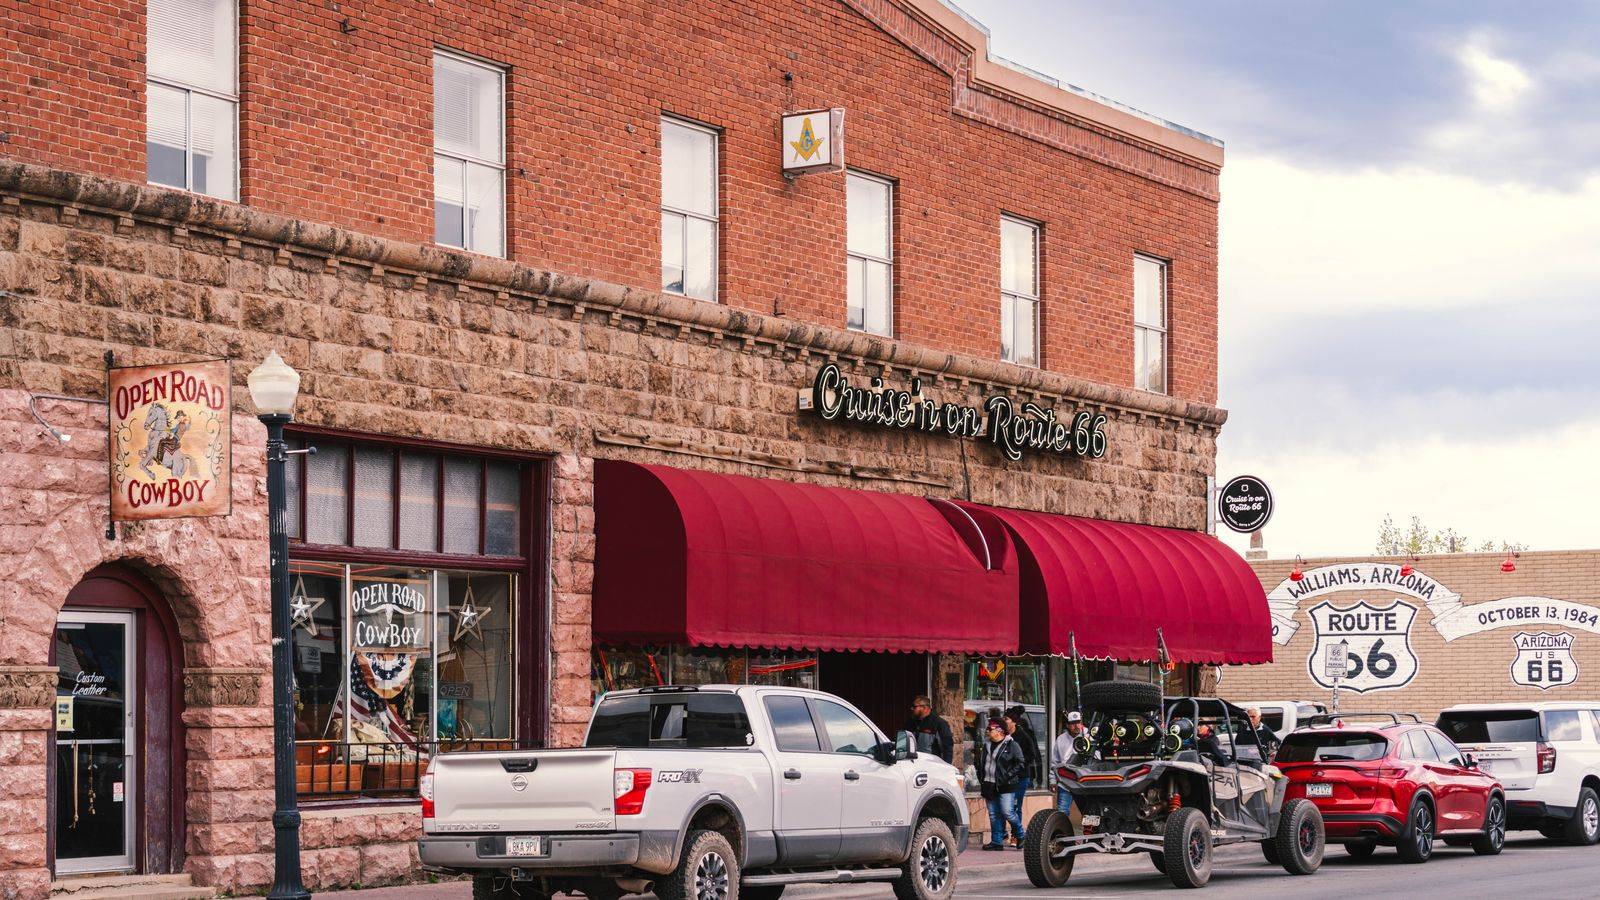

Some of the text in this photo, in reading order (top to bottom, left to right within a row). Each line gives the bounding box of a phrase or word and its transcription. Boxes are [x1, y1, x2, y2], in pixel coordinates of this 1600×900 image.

[115, 370, 224, 420] OPEN ROAD
[814, 363, 1107, 460] Cruise'n on Route 66
[1229, 502, 1262, 513] Route 66
[1287, 567, 1437, 599] WILLIAMS, ARIZONA
[352, 583, 426, 613] OPEN ROAD
[1328, 612, 1397, 632] ROUTE
[1478, 606, 1541, 625] OCTOBER
[1564, 608, 1599, 627] 1984
[1521, 636, 1569, 648] ARIZONA
[76, 671, 105, 683] Custom
[1527, 660, 1563, 682] 66
[72, 683, 107, 696] Leather
[439, 684, 472, 698] OPEN
[437, 822, 500, 831] TITAN XD
